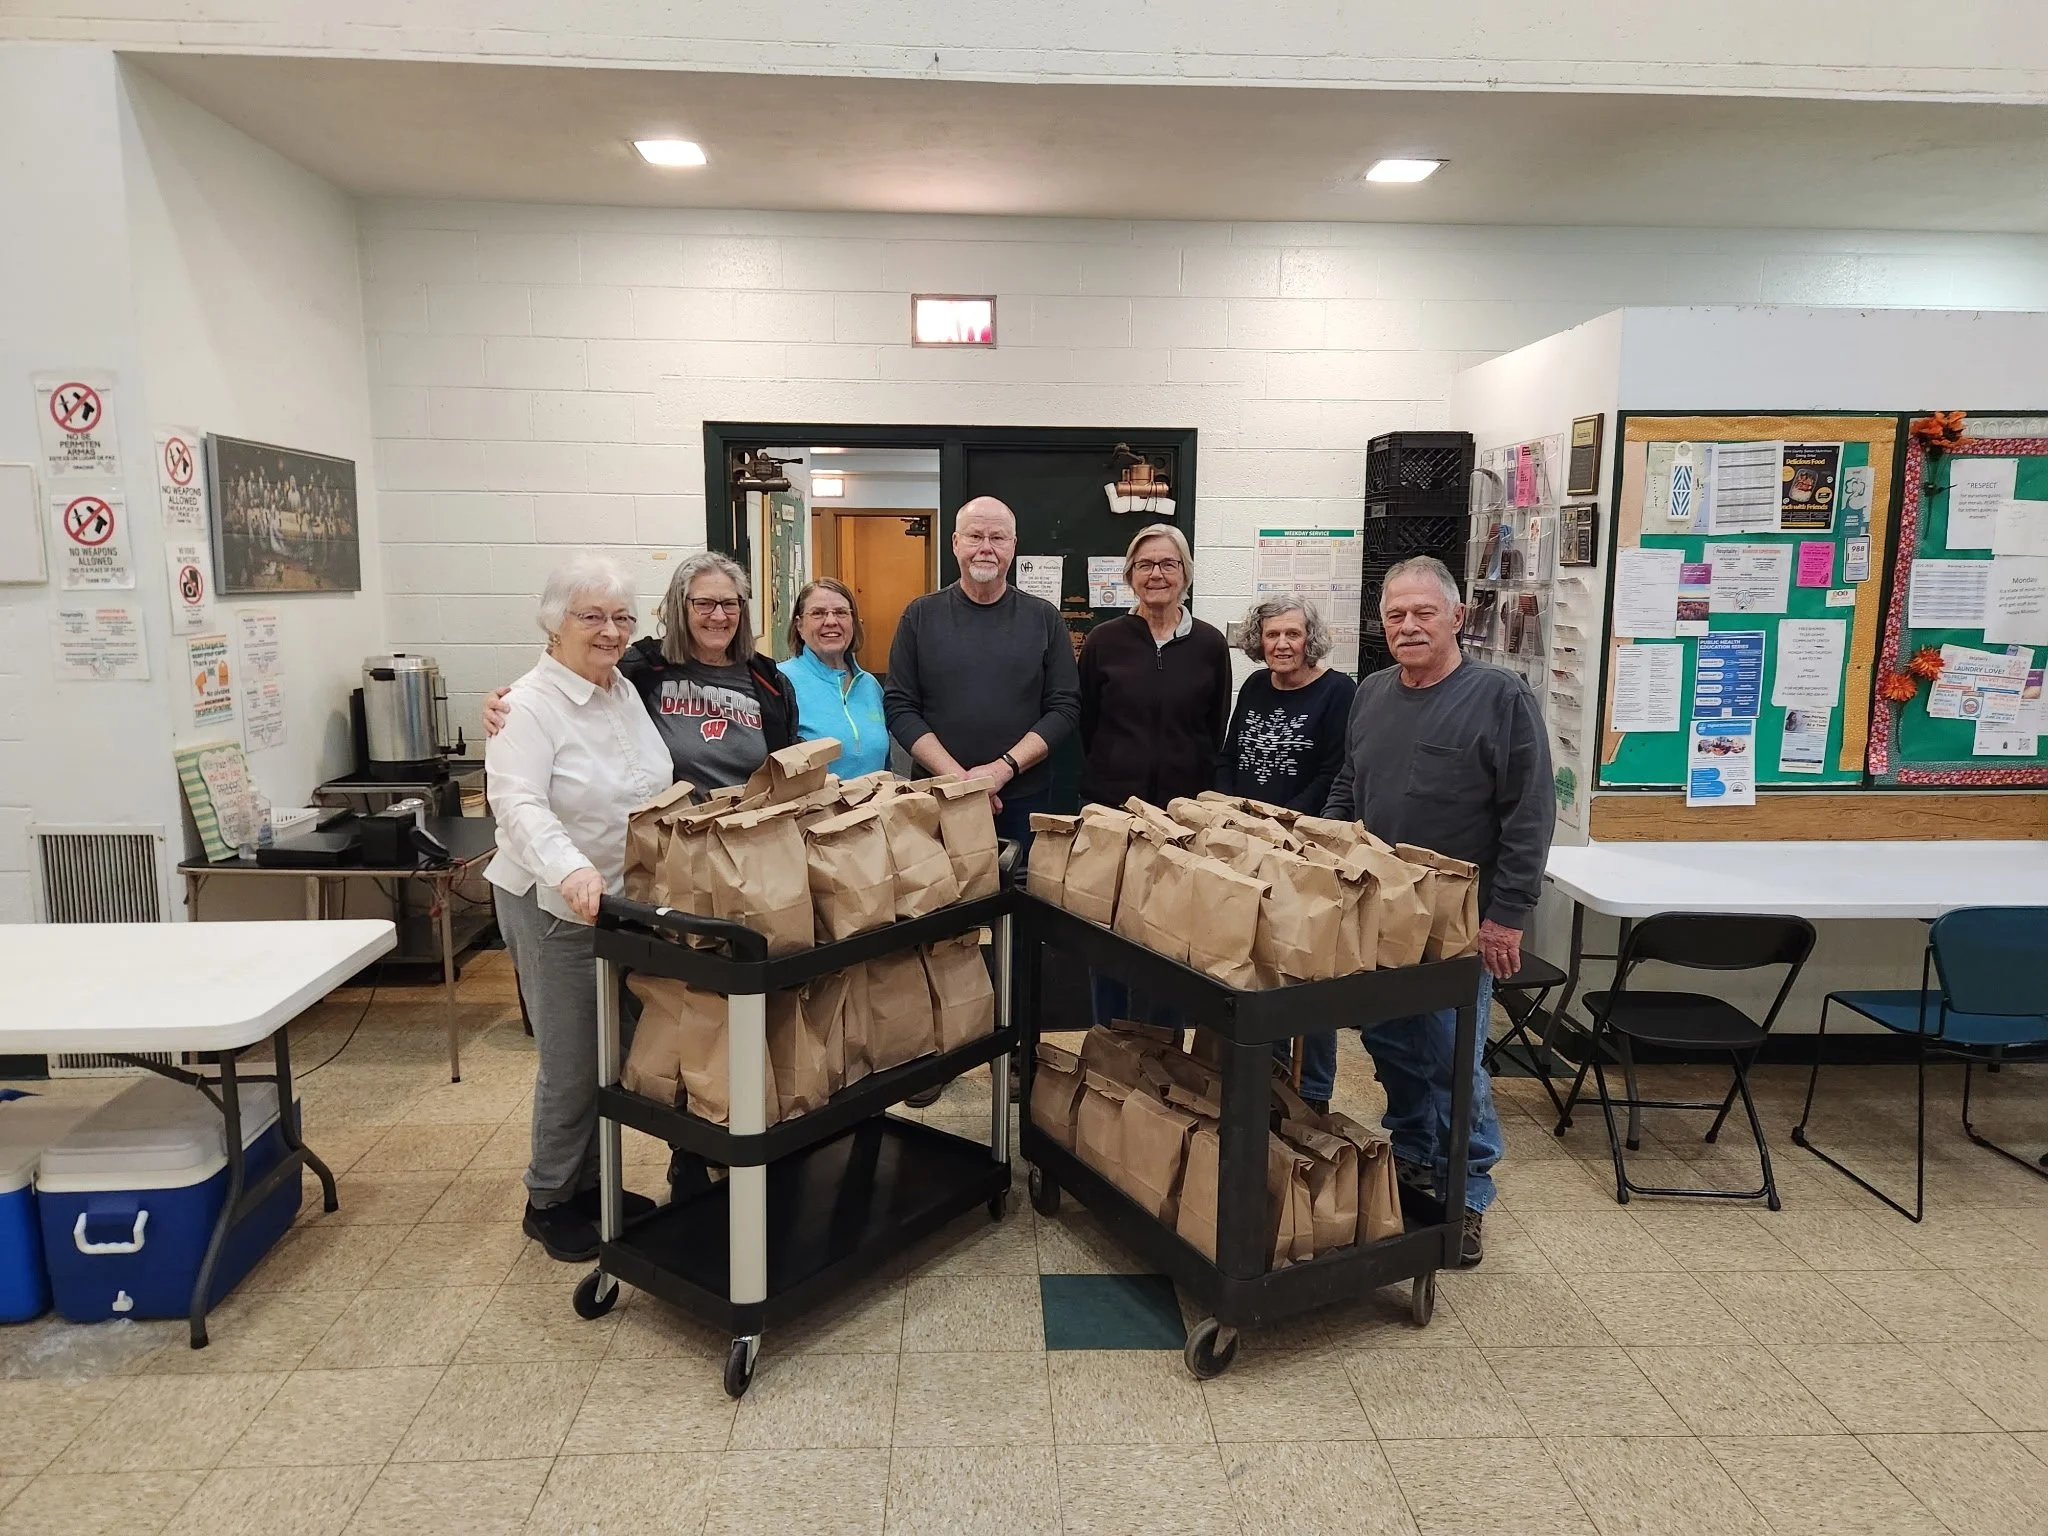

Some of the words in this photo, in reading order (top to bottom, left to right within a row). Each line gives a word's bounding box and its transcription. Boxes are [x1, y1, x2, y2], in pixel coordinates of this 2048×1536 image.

[66, 433, 79, 441] NO
[80, 432, 92, 441] SE
[59, 440, 101, 449] PERMITEN
[67, 448, 96, 456] ARMAS
[162, 486, 171, 494] NO
[173, 486, 202, 497] WEAPONS
[169, 496, 198, 506] ALLOWED
[69, 547, 80, 556] NO
[82, 547, 118, 556] WEAPONS
[78, 556, 113, 566] ALLOWED
[1954, 665, 1983, 673] LAUNDRY
[1984, 667, 2005, 675] LOVE!
[660, 680, 762, 730] BADGERS
[700, 719, 728, 742] W
